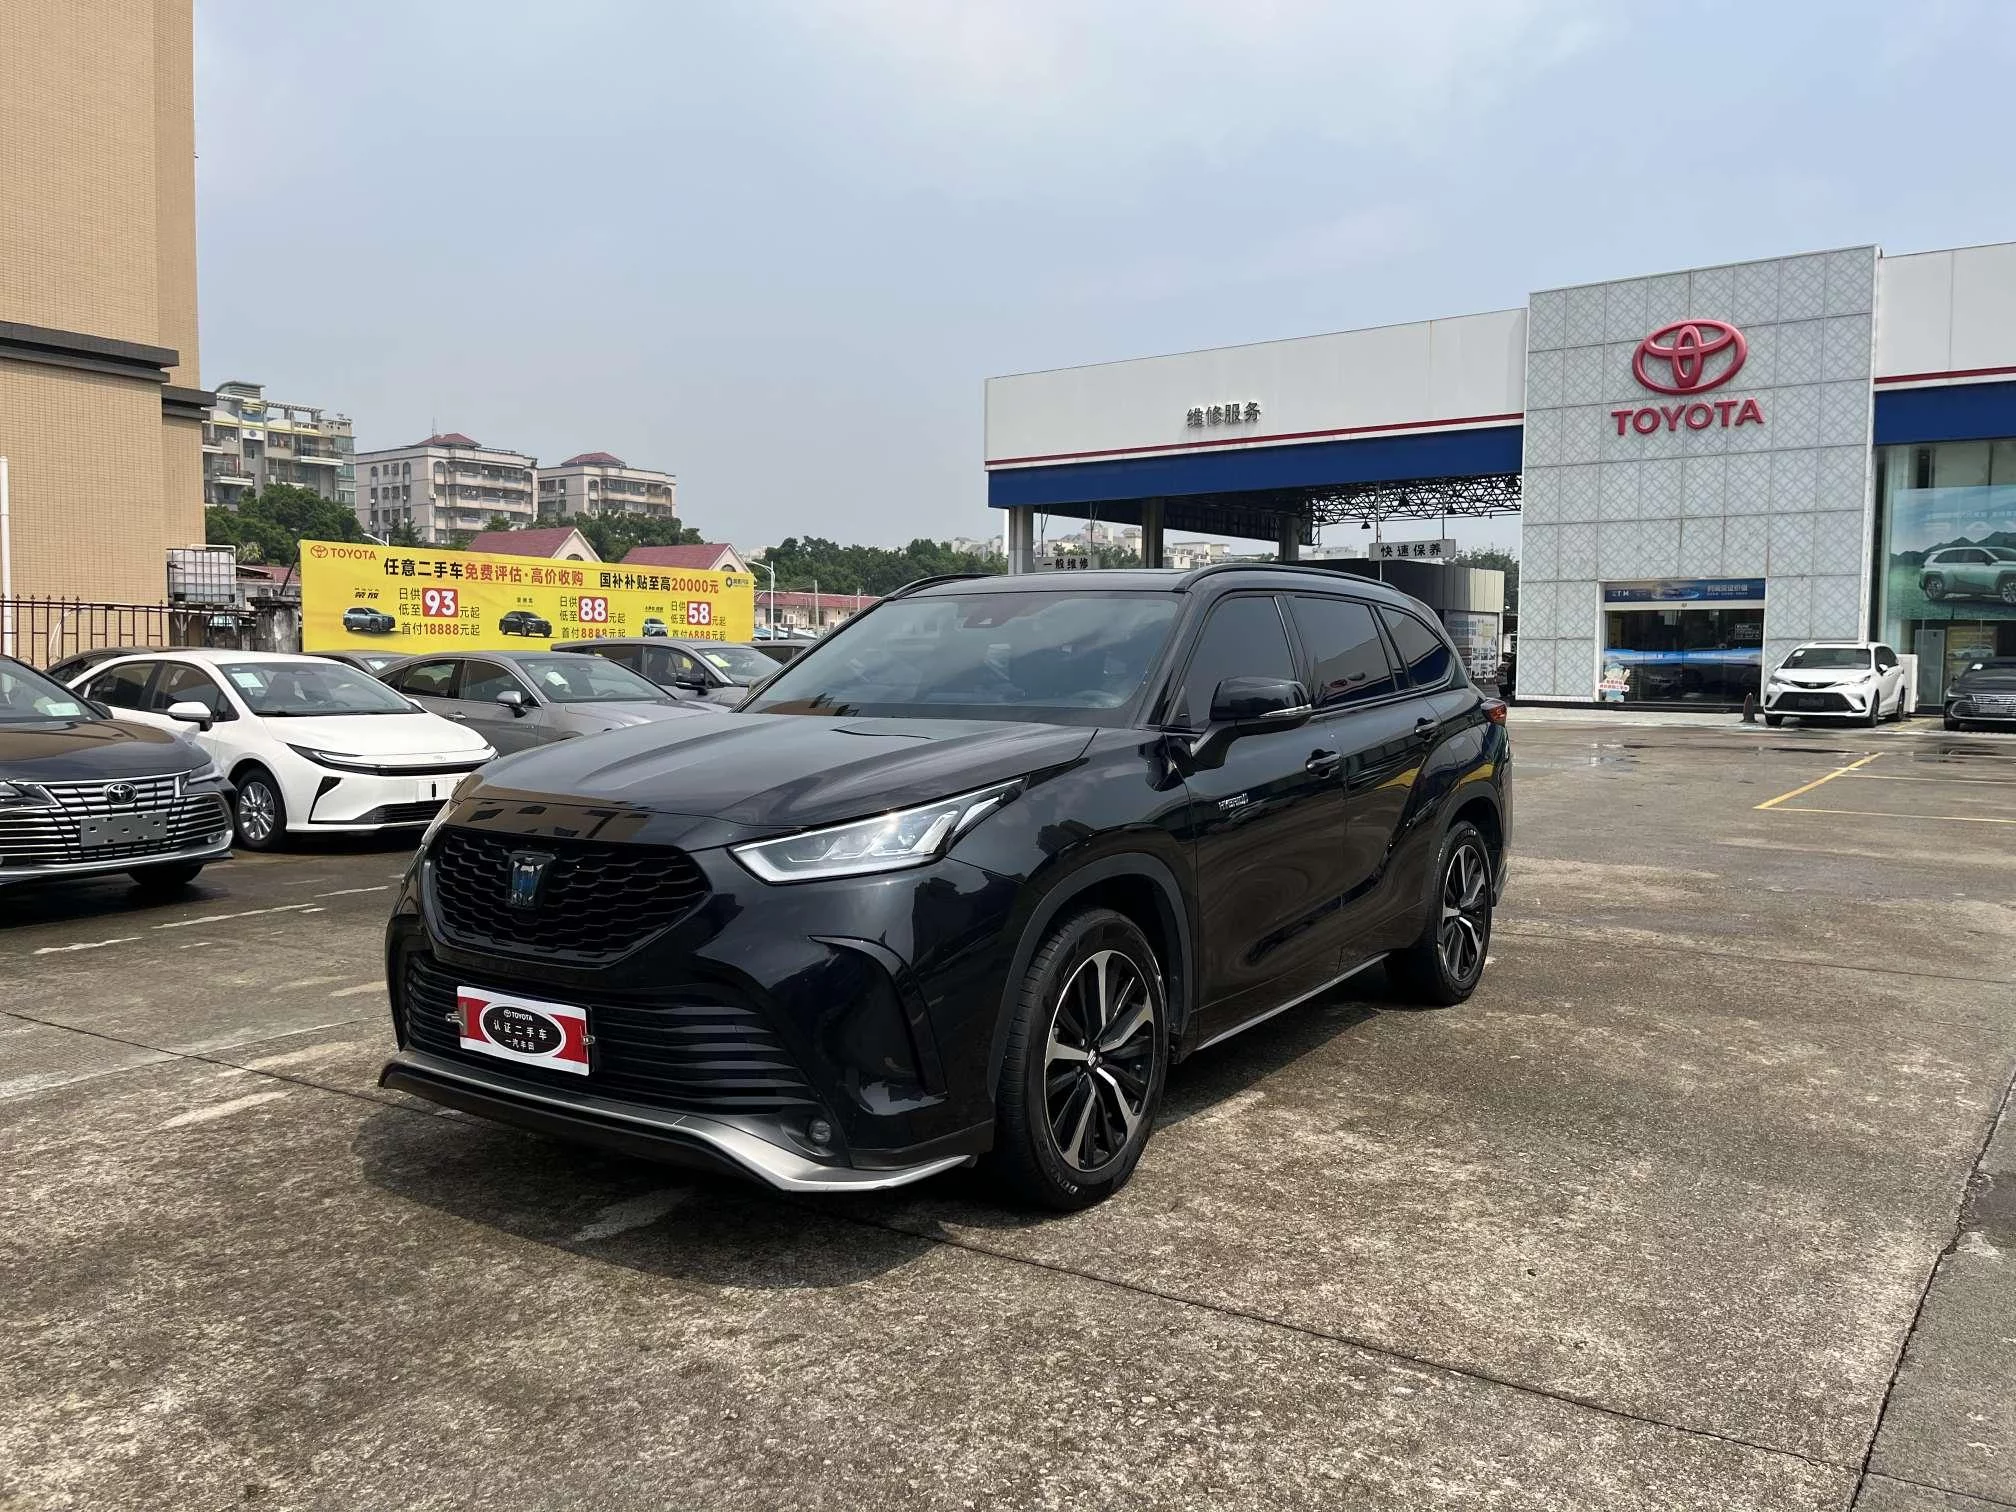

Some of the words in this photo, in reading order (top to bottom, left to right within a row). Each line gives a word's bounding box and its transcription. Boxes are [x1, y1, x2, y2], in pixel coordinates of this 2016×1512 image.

[1186, 402, 1261, 427] 维修服务
[1611, 398, 1765, 436] TOYOTA
[330, 548, 377, 561] TOYOTA
[1380, 543, 1442, 557] 快速保养
[1043, 557, 1088, 569] 一般维修
[384, 558, 584, 586] 任意二手车免费评估·高价收购
[600, 572, 719, 594] 国补补贴至高20000元
[399, 588, 421, 600] 日供
[399, 603, 421, 616] 低至
[425, 590, 457, 616] 93
[460, 606, 480, 619] 元起
[560, 596, 577, 608] 日供
[671, 601, 686, 612] 日供
[560, 610, 578, 622] 低至
[580, 598, 607, 622] 88
[609, 613, 626, 624] 元起
[670, 614, 686, 625] 低至
[688, 603, 710, 624] 58
[711, 616, 727, 627] 元起
[401, 623, 480, 636] 首付18888元起
[511, 1011, 533, 1022] TOYOTA
[493, 1019, 548, 1041] 认证二手车
[505, 1038, 535, 1051] 一汽丰田
